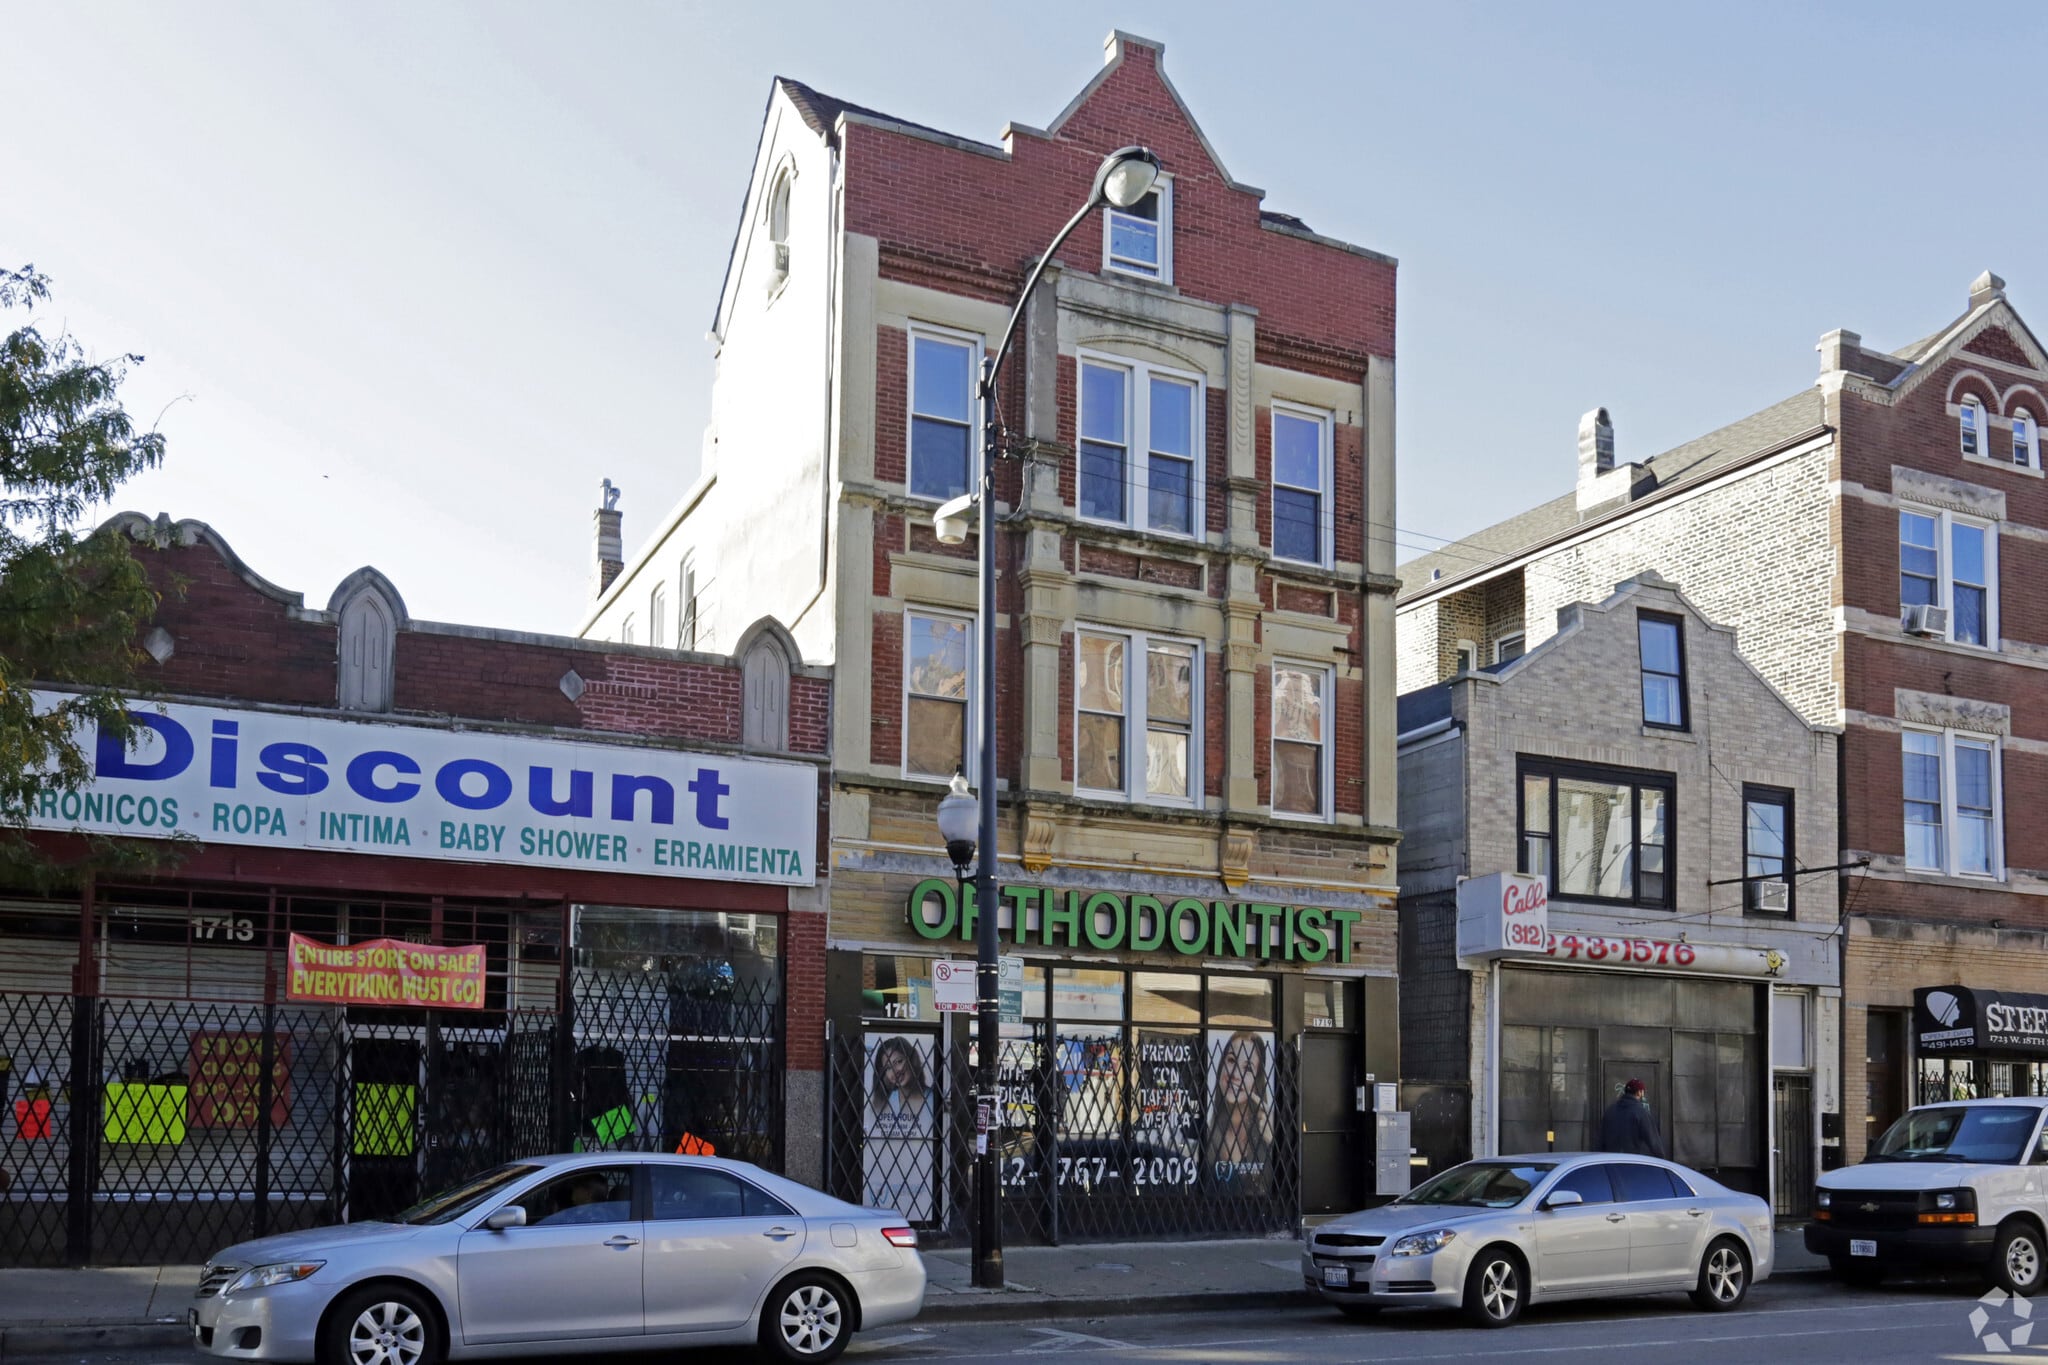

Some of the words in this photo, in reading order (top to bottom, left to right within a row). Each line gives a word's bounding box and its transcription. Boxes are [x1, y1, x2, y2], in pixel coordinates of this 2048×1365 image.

[96, 711, 730, 831] Discount
[213, 802, 287, 836] ROPA
[320, 811, 411, 846] INTIMA
[440, 820, 506, 853] BABY
[519, 826, 628, 863] SHOWER
[654, 838, 803, 877] ERRAMIENTA
[191, 917, 254, 942] 1713
[1504, 921, 1546, 949] (312)
[294, 943, 353, 967] ENTIRE
[357, 948, 407, 969] STORE
[410, 952, 435, 971] ON
[438, 954, 480, 973] SALE!
[292, 969, 399, 1000] EVERYTHING
[402, 975, 450, 1002] MUST
[452, 978, 481, 1003] GO!
[884, 1002, 918, 1018] 1719
[937, 1002, 953, 1010] TOW
[957, 1003, 974, 1011] ZONE
[1986, 1001, 2048, 1034] STEF
[1928, 1038, 1975, 1049] 491-1459
[1989, 1035, 2008, 1045] 1723
[2009, 1035, 2021, 1044] W.
[2022, 1036, 2045, 1046] 18TH
[1142, 1044, 1191, 1063] FRENOS
[998, 1064, 1025, 1081] ITH
[1000, 1083, 1036, 1104] DICAL
[1000, 1107, 1027, 1128] ARD
[1133, 1157, 1198, 1185] 2009
